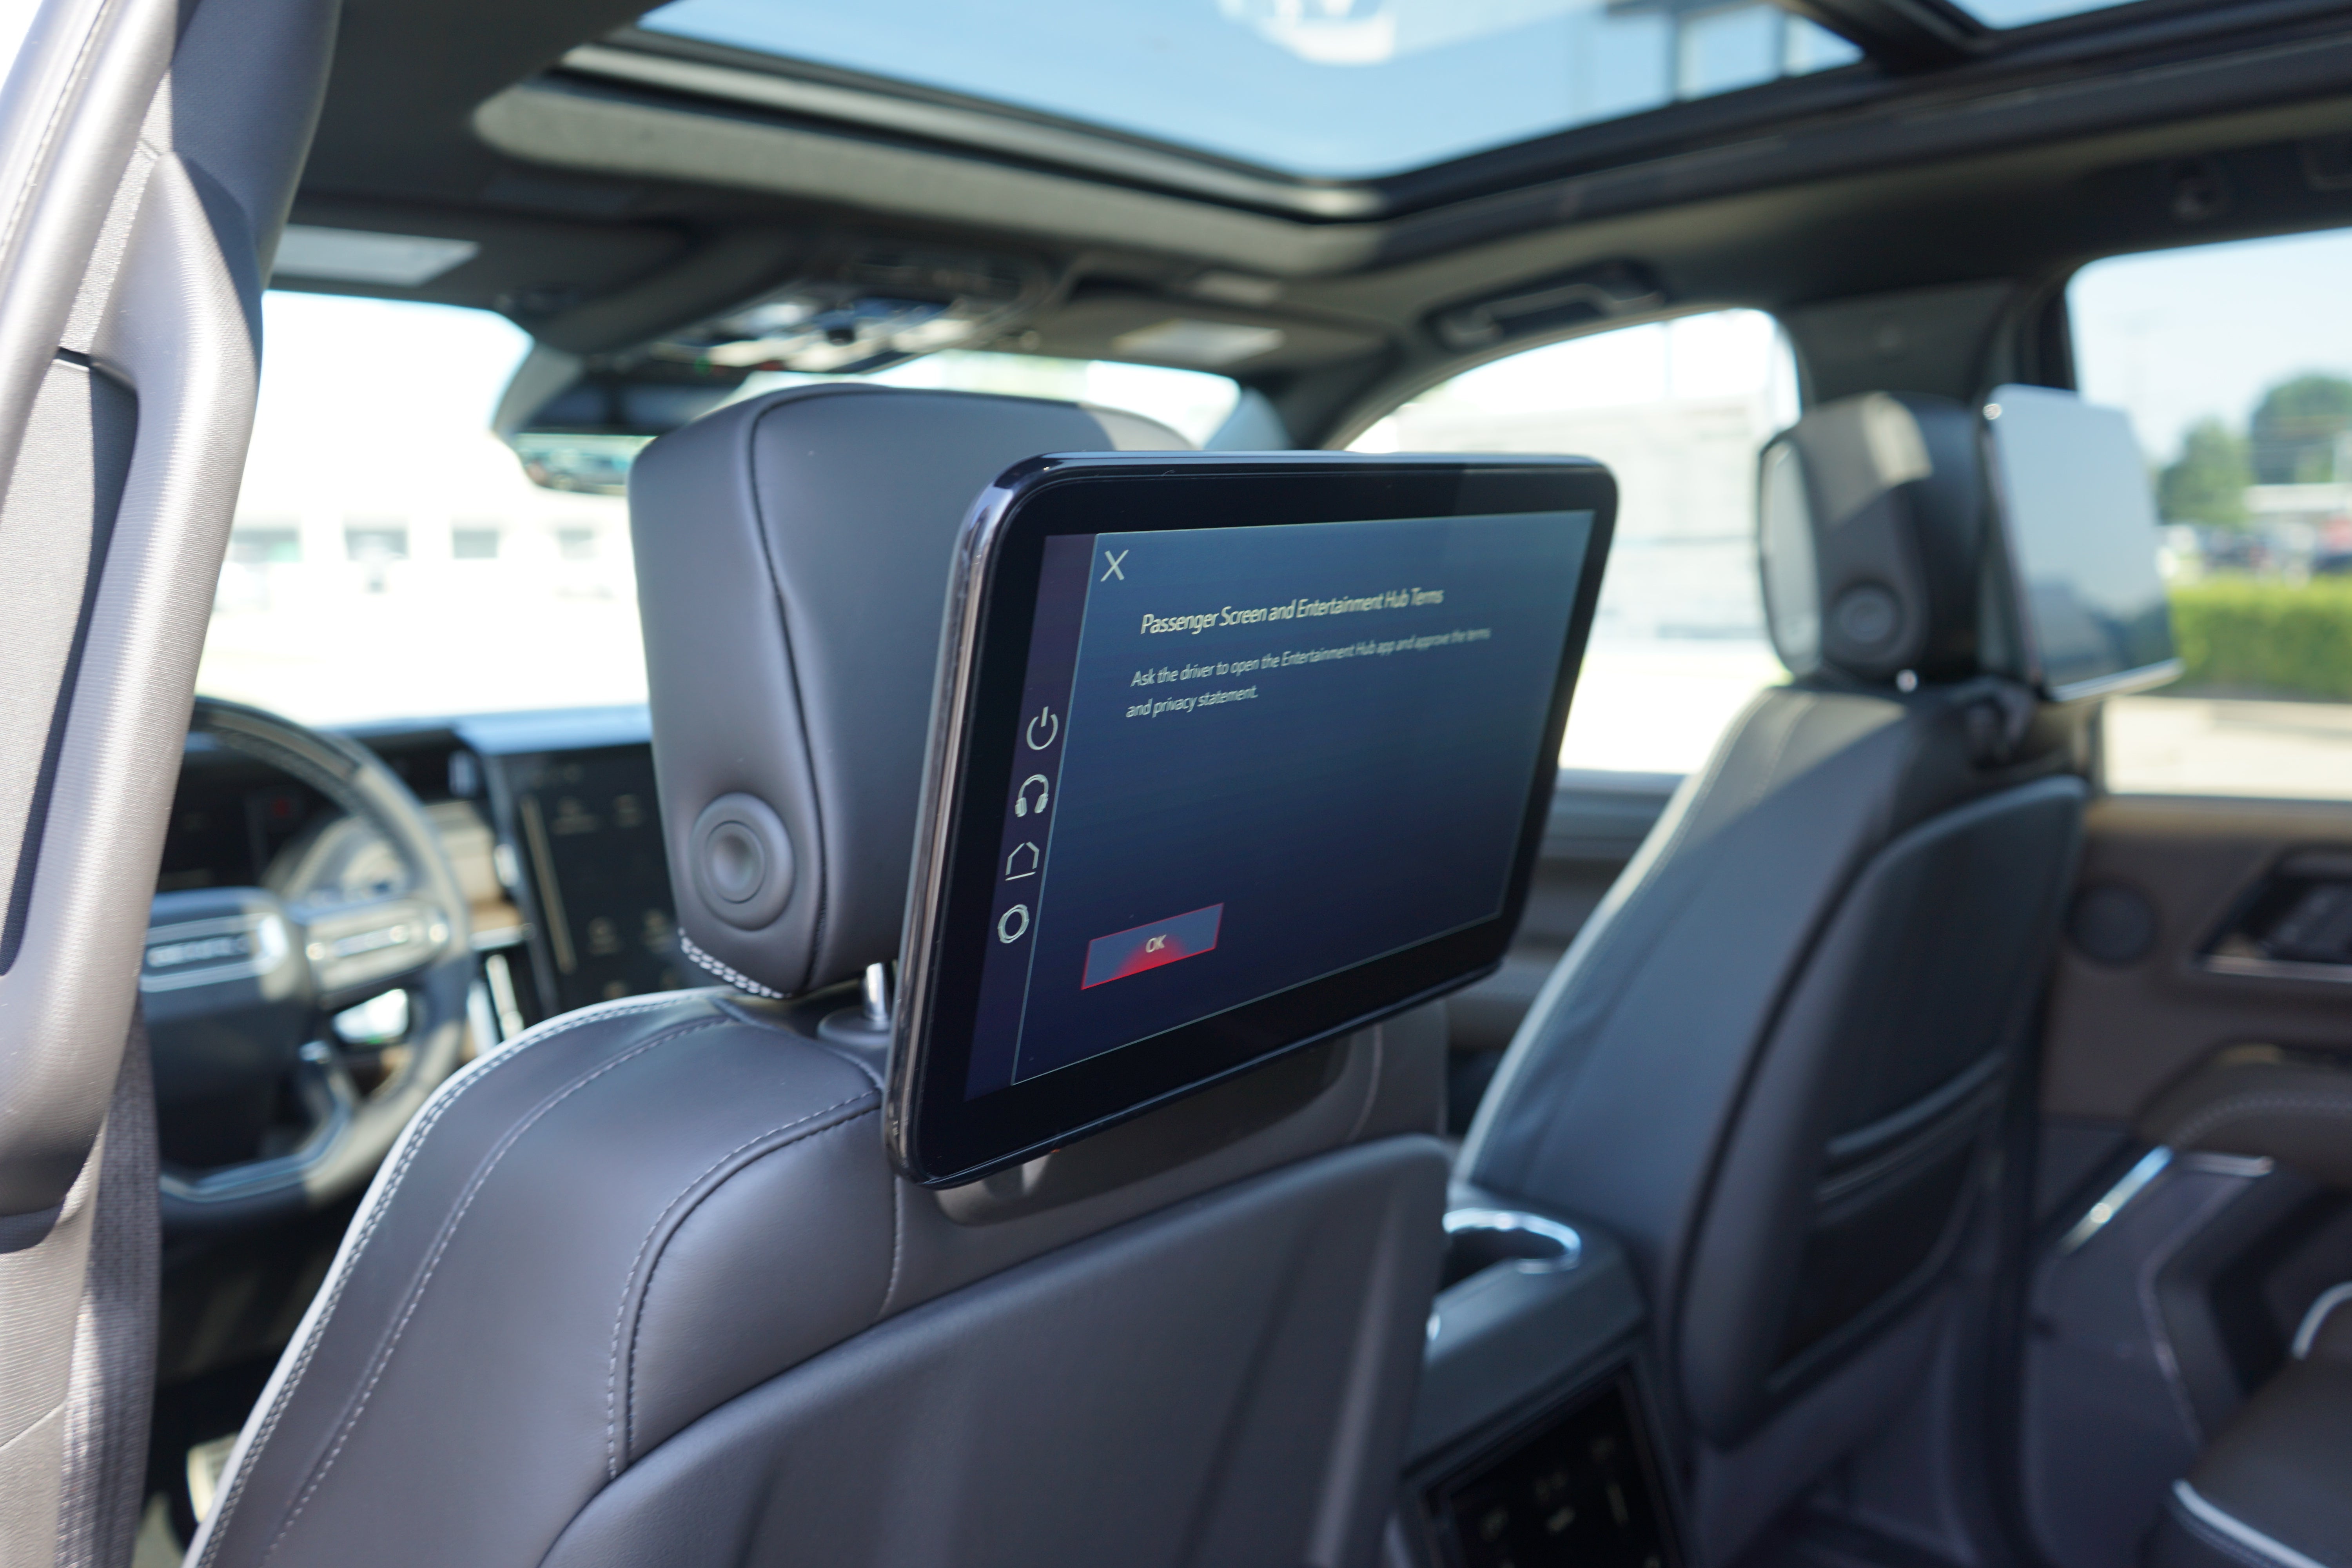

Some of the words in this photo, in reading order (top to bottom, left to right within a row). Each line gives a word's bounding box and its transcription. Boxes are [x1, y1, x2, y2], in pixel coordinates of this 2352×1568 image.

[1140, 613, 1219, 634] Passenger
[1219, 606, 1267, 626] Screen
[1268, 599, 1296, 621] and
[1296, 594, 1385, 618] Entertainment
[1384, 588, 1410, 608] Hub
[1410, 587, 1445, 606] Terms
[1130, 668, 1156, 687] Ask
[1157, 666, 1178, 683] the
[1180, 663, 1215, 680] driver
[1216, 661, 1229, 675] to
[1230, 659, 1259, 676] open
[1261, 653, 1280, 668] the
[1280, 645, 1355, 666] Entertainment
[1355, 640, 1376, 655] Hub
[1376, 641, 1396, 657] app
[1125, 698, 1153, 718] and
[1152, 697, 1198, 718] privacy
[1197, 685, 1259, 707] statement.
[1145, 934, 1167, 953] OK
